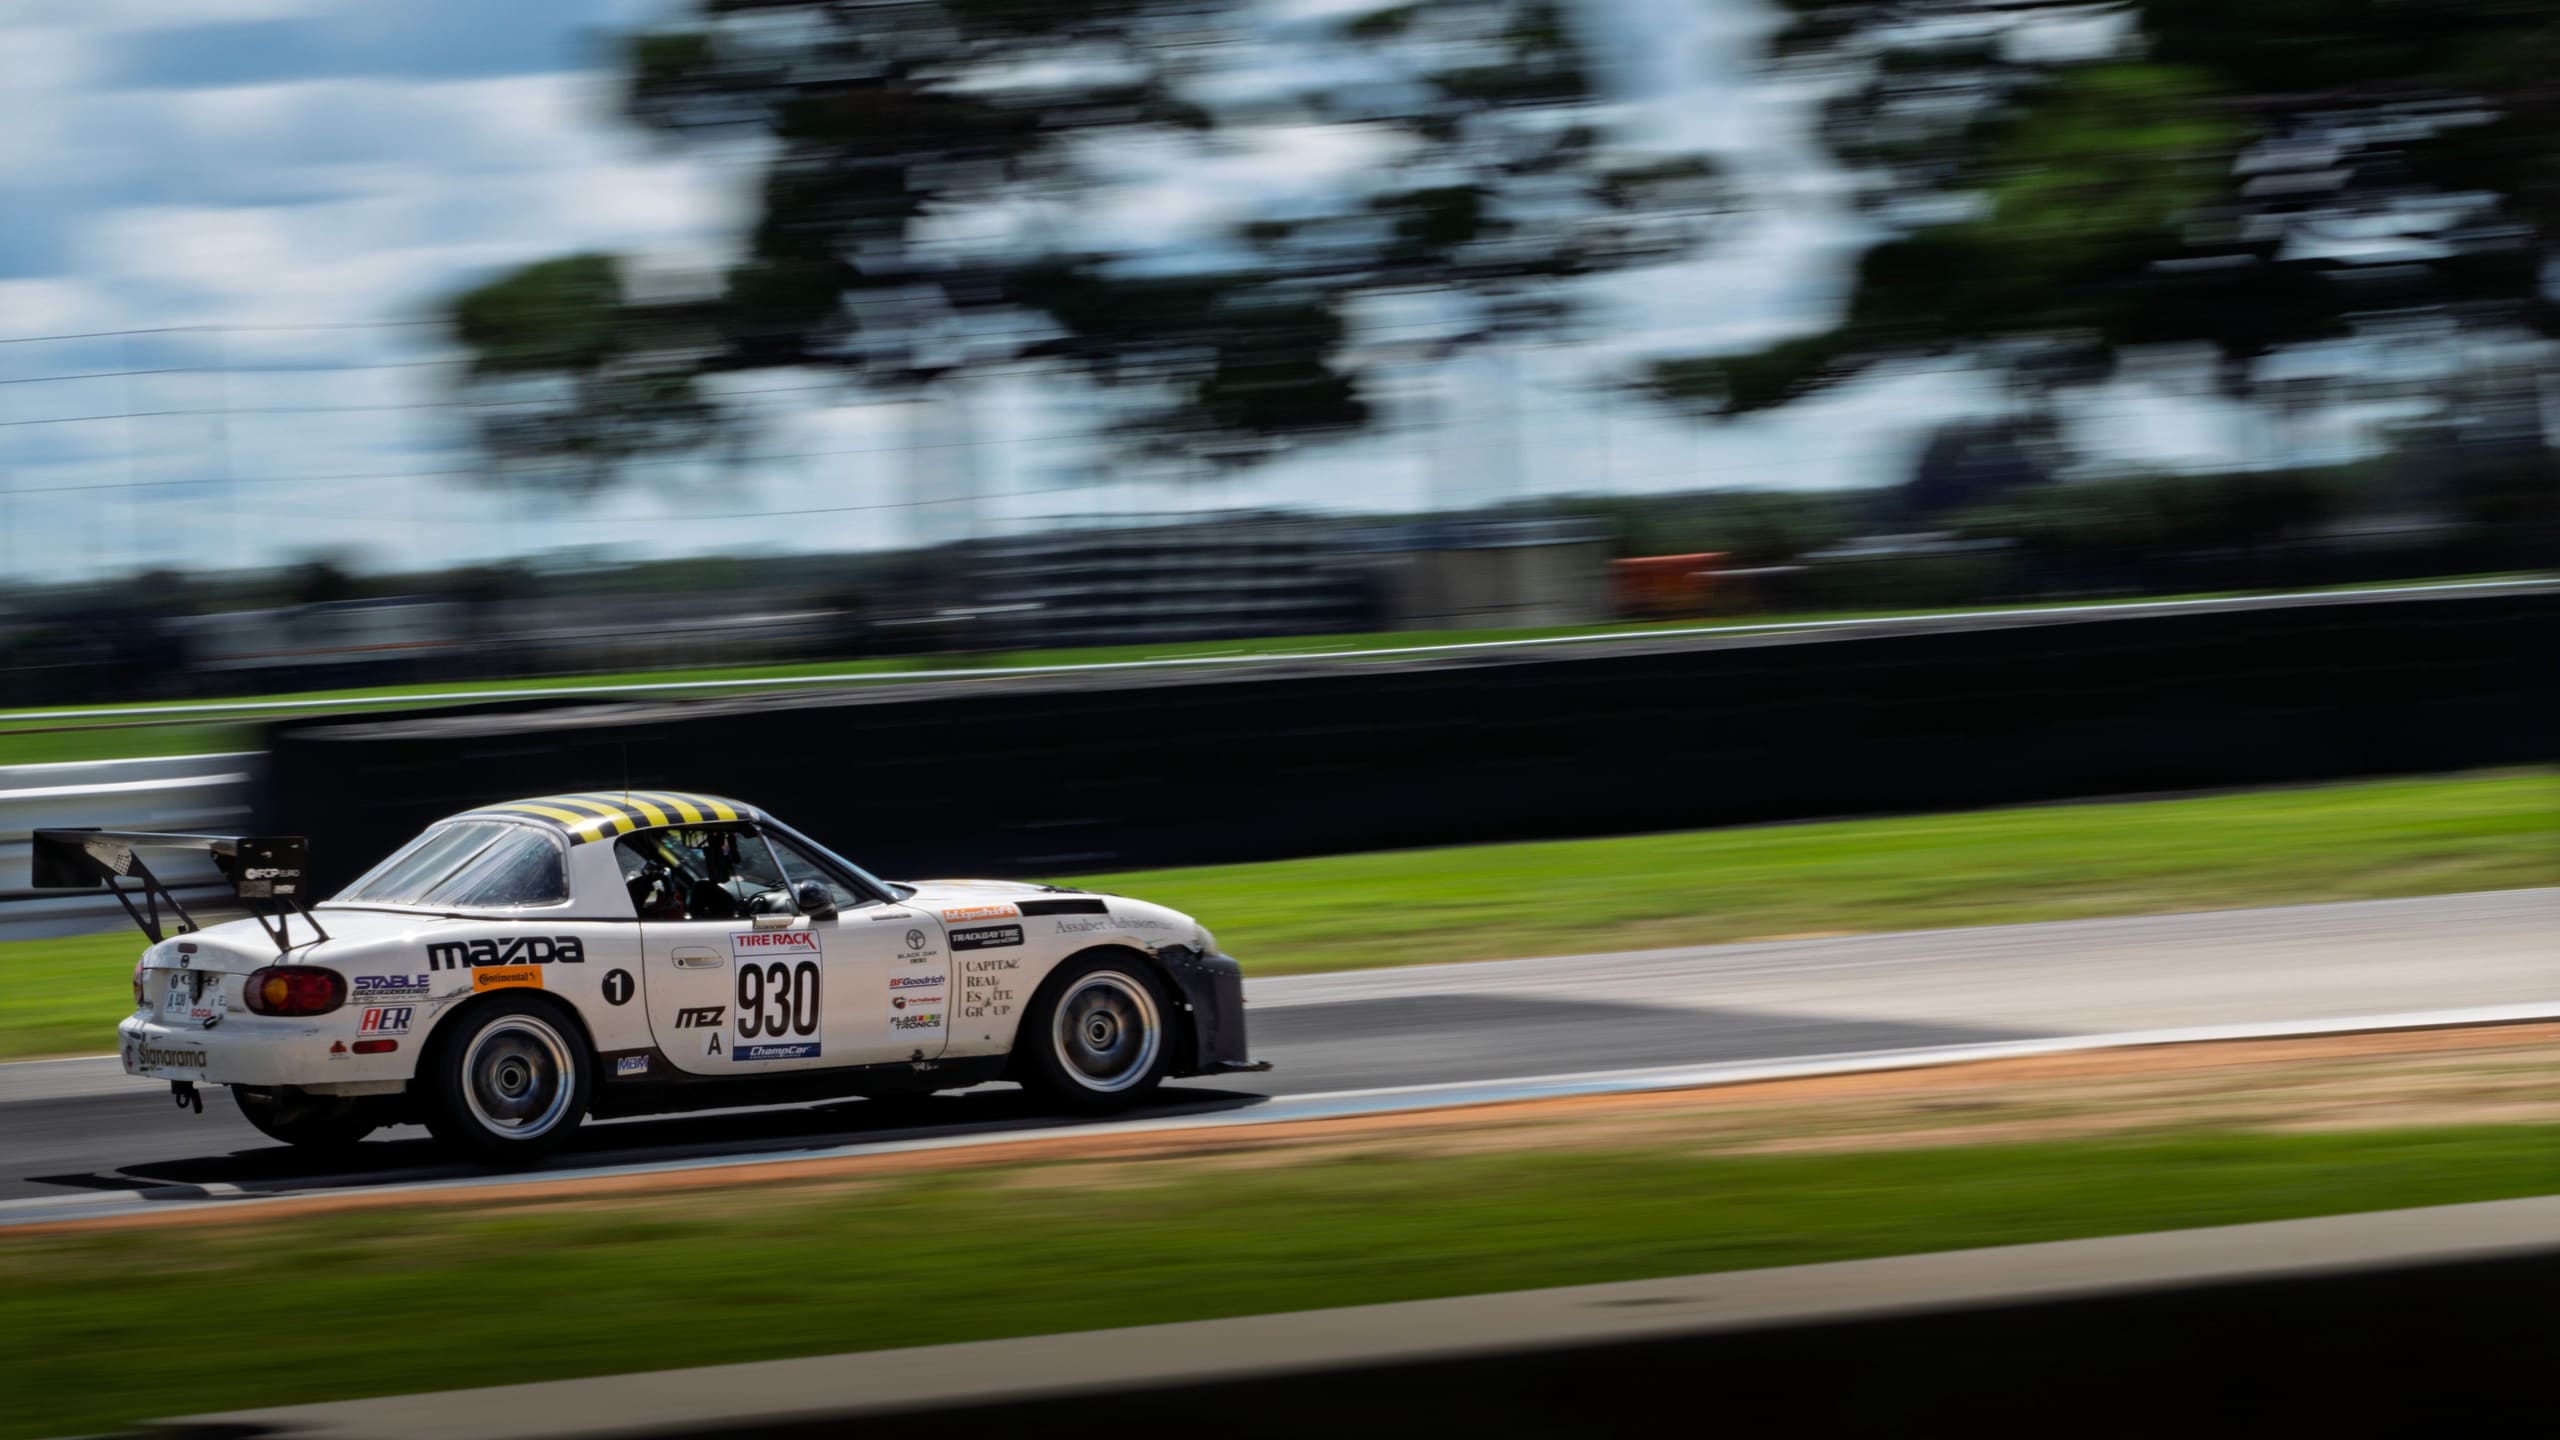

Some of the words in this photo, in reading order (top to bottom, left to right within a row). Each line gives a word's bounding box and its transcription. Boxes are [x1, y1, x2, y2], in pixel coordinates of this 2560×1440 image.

[736, 935, 771, 947] TIRE
[772, 932, 817, 950] RACK
[354, 974, 431, 990] STABLE
[478, 971, 530, 986] Continental
[889, 975, 946, 988] BFGoodrich
[966, 976, 999, 988] REAL
[609, 973, 623, 1001] 1
[737, 960, 820, 1039] 930
[361, 1007, 413, 1031] AER
[890, 1016, 917, 1025] FLAG
[896, 1020, 942, 1030] TRONICS
[707, 1031, 722, 1056] A
[750, 1045, 806, 1058] ChampCar
[139, 1042, 208, 1070] Signarama
